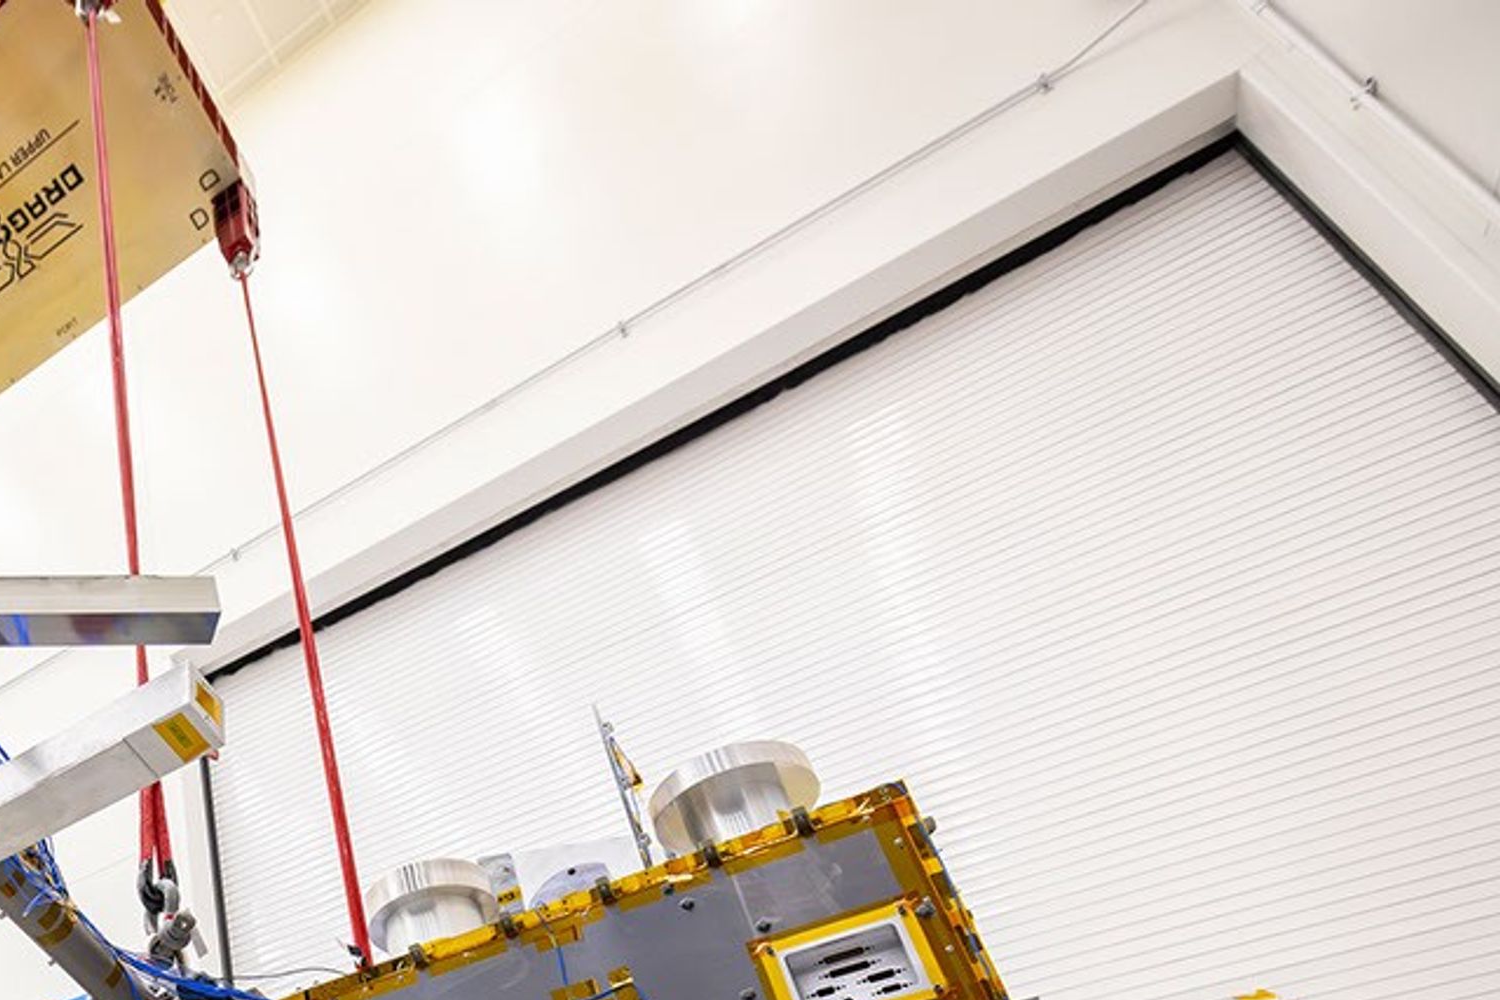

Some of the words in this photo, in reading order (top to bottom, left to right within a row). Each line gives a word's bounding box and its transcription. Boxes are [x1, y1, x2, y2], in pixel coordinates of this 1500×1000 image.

[10, 128, 51, 166] UPPER
[199, 168, 221, 191] D
[189, 208, 209, 231] D
